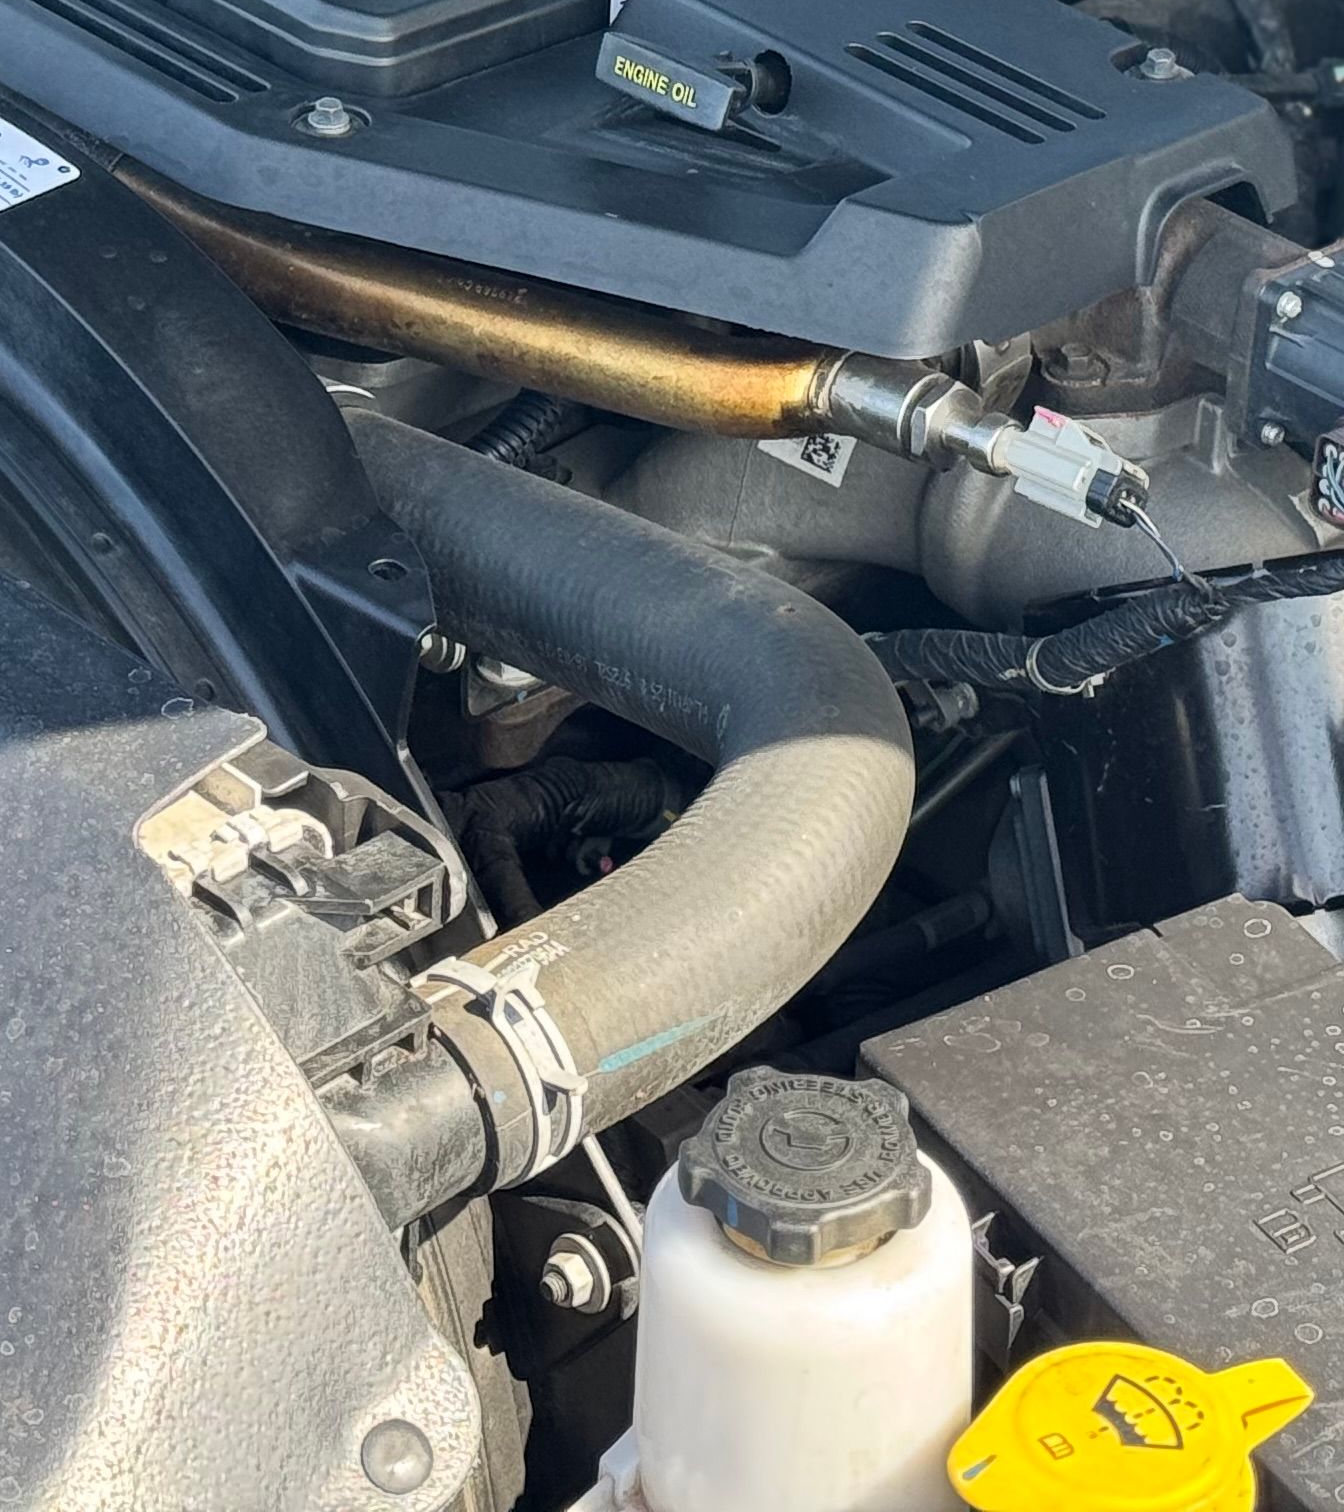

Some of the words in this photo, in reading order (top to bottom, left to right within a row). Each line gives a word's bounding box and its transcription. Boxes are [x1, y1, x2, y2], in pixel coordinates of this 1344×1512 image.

[613, 54, 671, 96] ENGINE
[671, 82, 697, 109] OIL
[502, 931, 549, 958] RAD
[749, 1078, 867, 1105] STEERING
[722, 1153, 833, 1202] APPROVED
